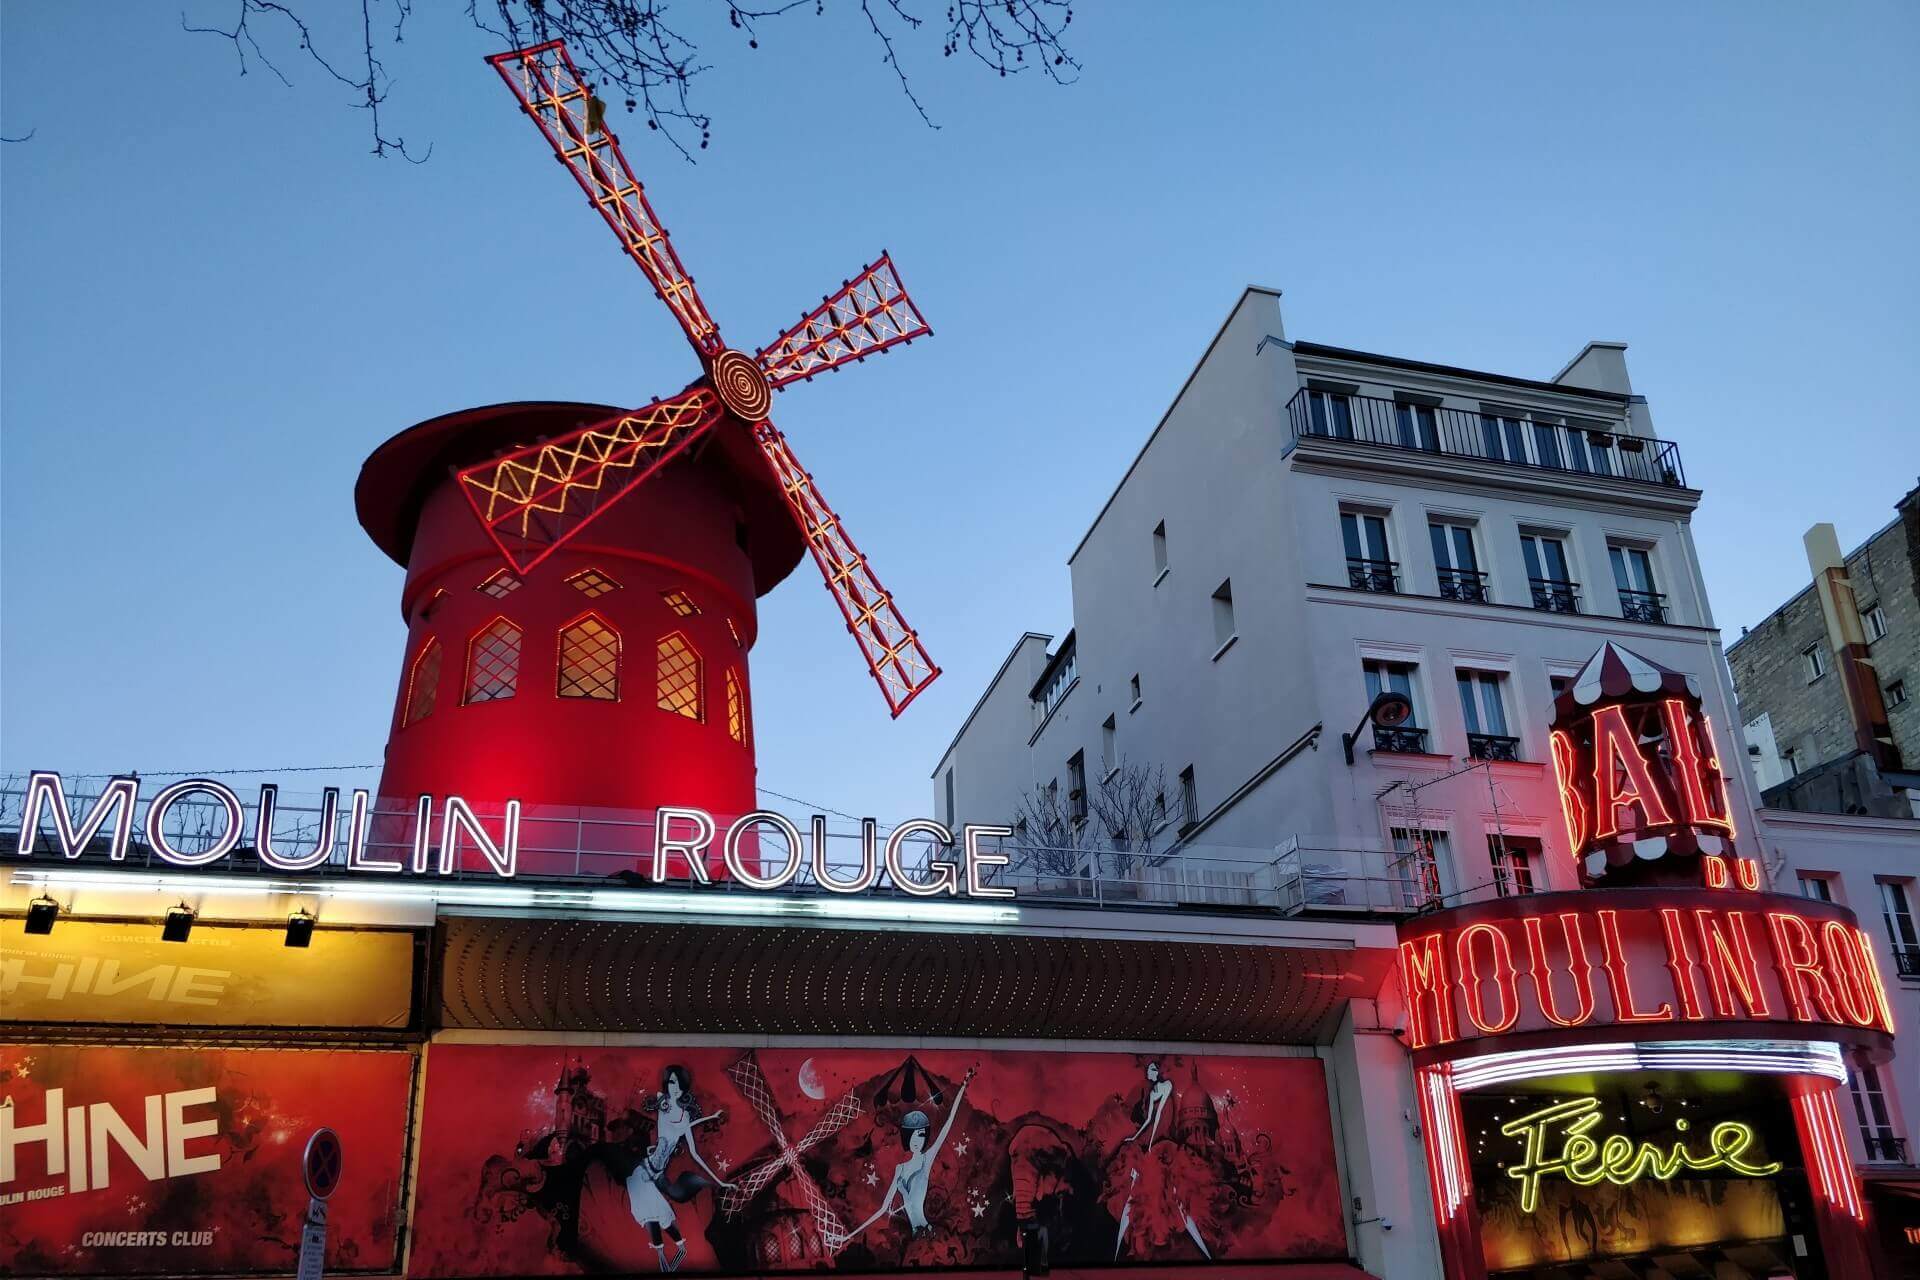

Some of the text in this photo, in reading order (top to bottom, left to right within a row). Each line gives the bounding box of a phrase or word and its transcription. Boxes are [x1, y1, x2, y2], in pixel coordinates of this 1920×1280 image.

[17, 769, 1018, 899] MOULIN ROUGE
[1550, 699, 1736, 858] BAL
[1705, 855, 1760, 891] DU
[1400, 908, 1769, 1048] MOULIN
[27, 1185, 65, 1201] ROUGE
[1502, 1097, 1783, 1213] Féerie
[82, 1231, 214, 1248] CONCERTS CLUB
